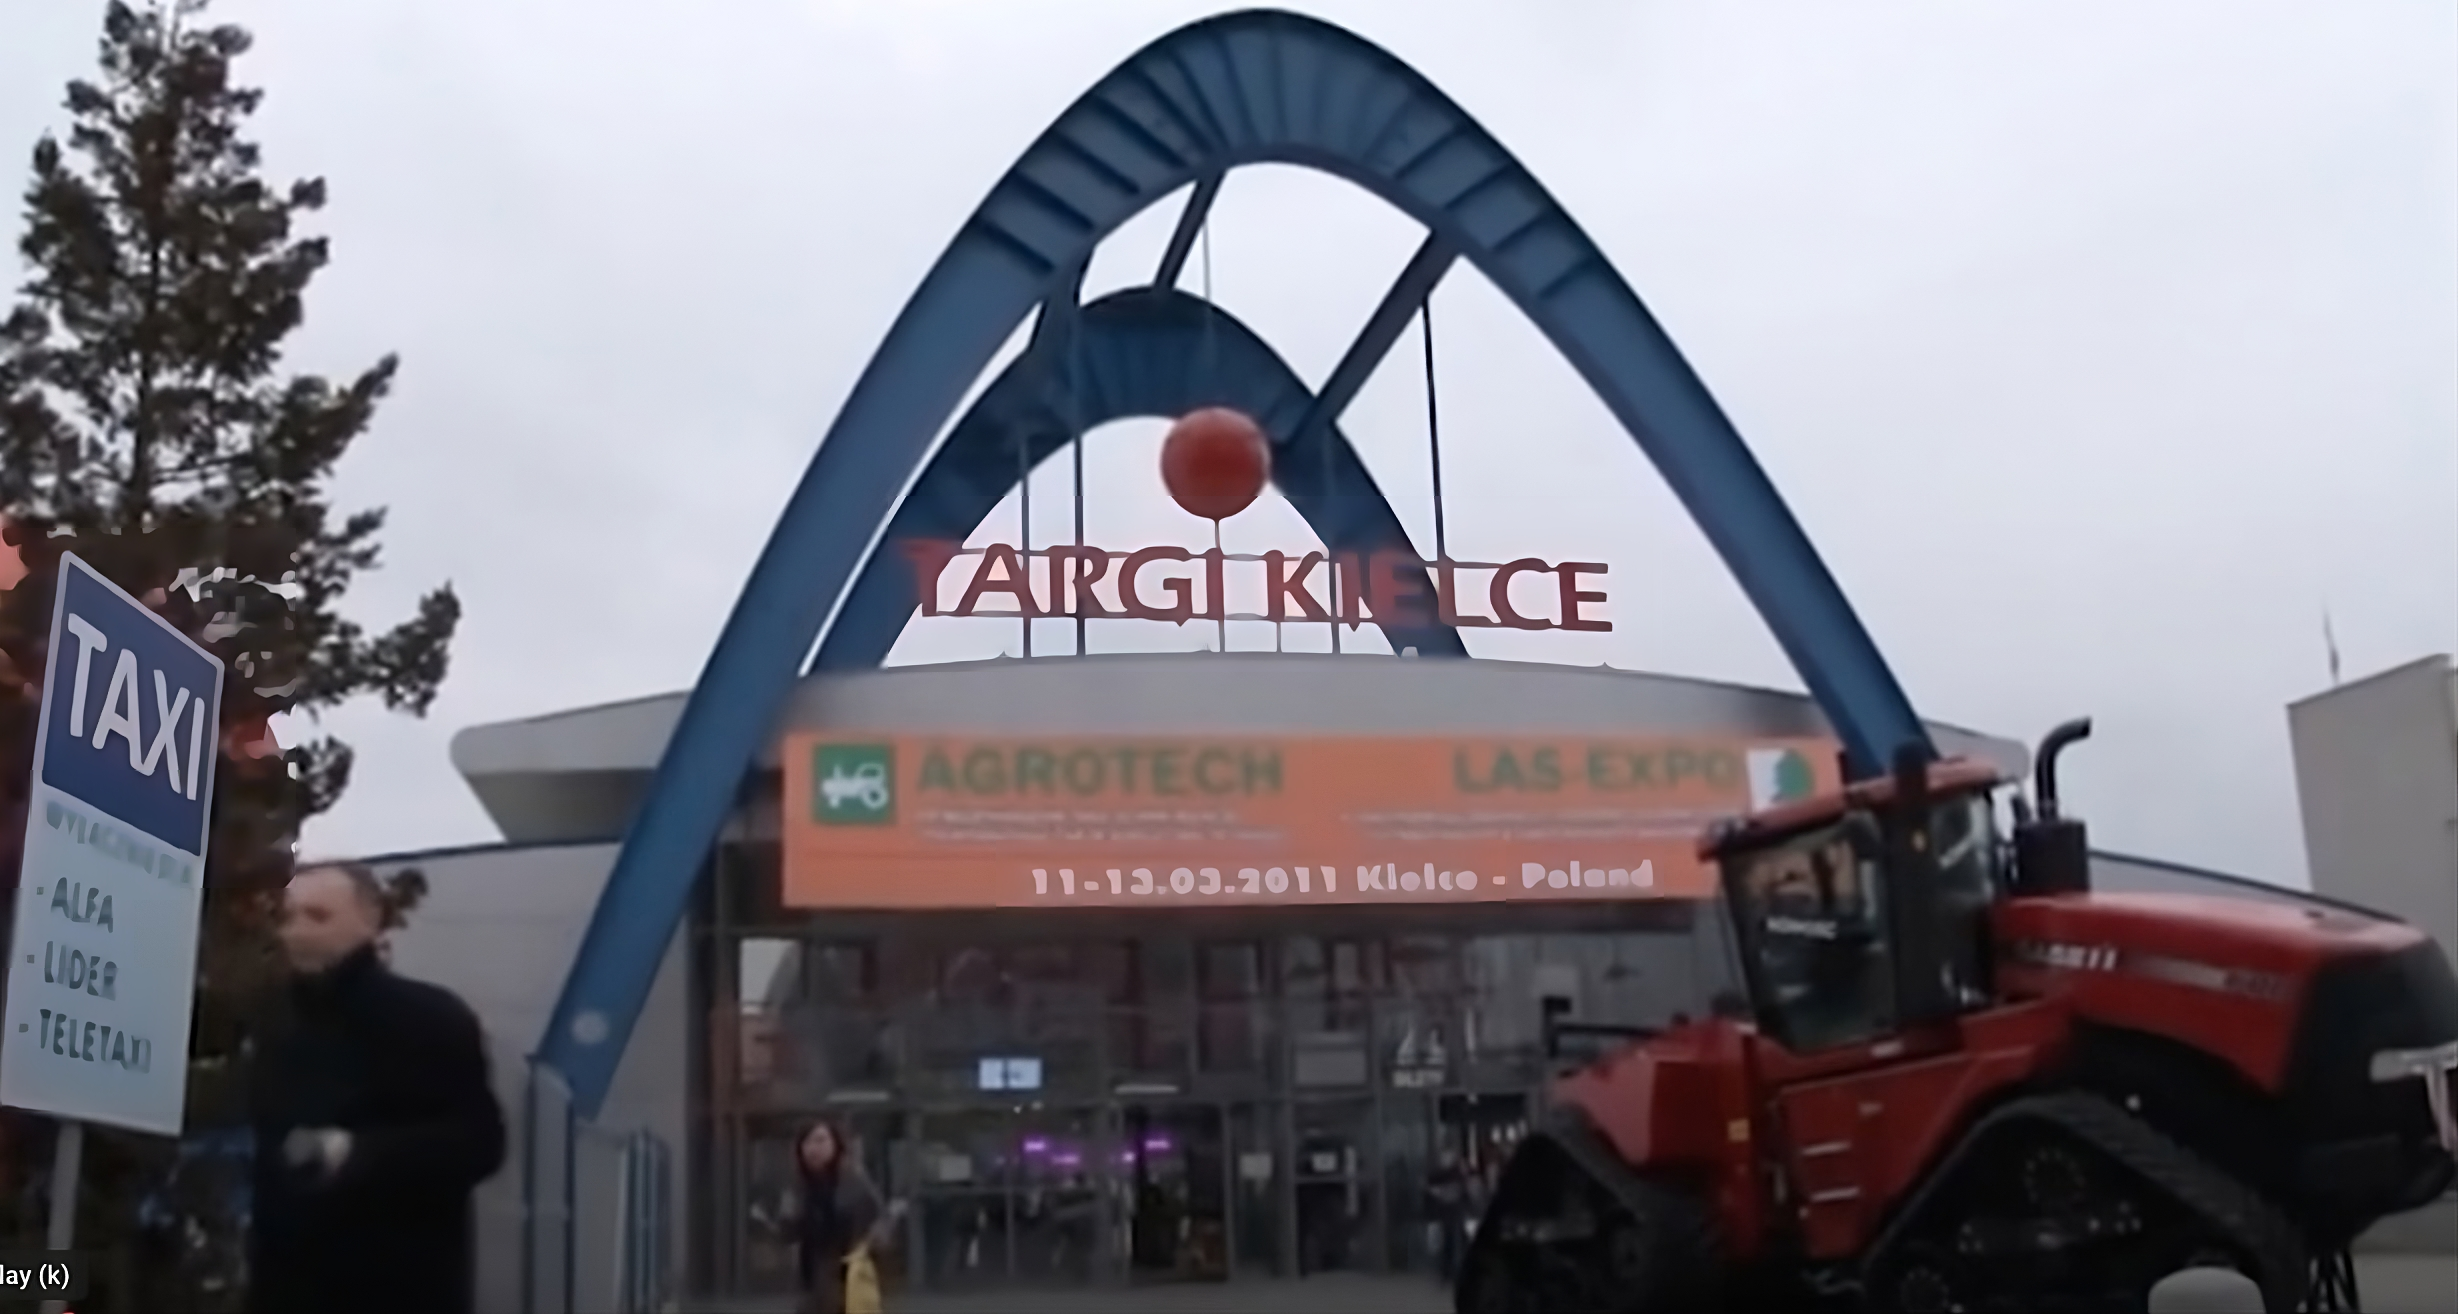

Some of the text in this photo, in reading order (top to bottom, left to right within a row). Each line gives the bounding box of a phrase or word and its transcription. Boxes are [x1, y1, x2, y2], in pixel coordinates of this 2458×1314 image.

[902, 541, 1613, 632] TARGI KIELCE
[67, 612, 205, 801] TAXI
[915, 745, 1285, 797] AGROTECH
[1521, 859, 1654, 889] Poland
[51, 876, 114, 934] ALFA
[44, 940, 118, 1001] LIDER
